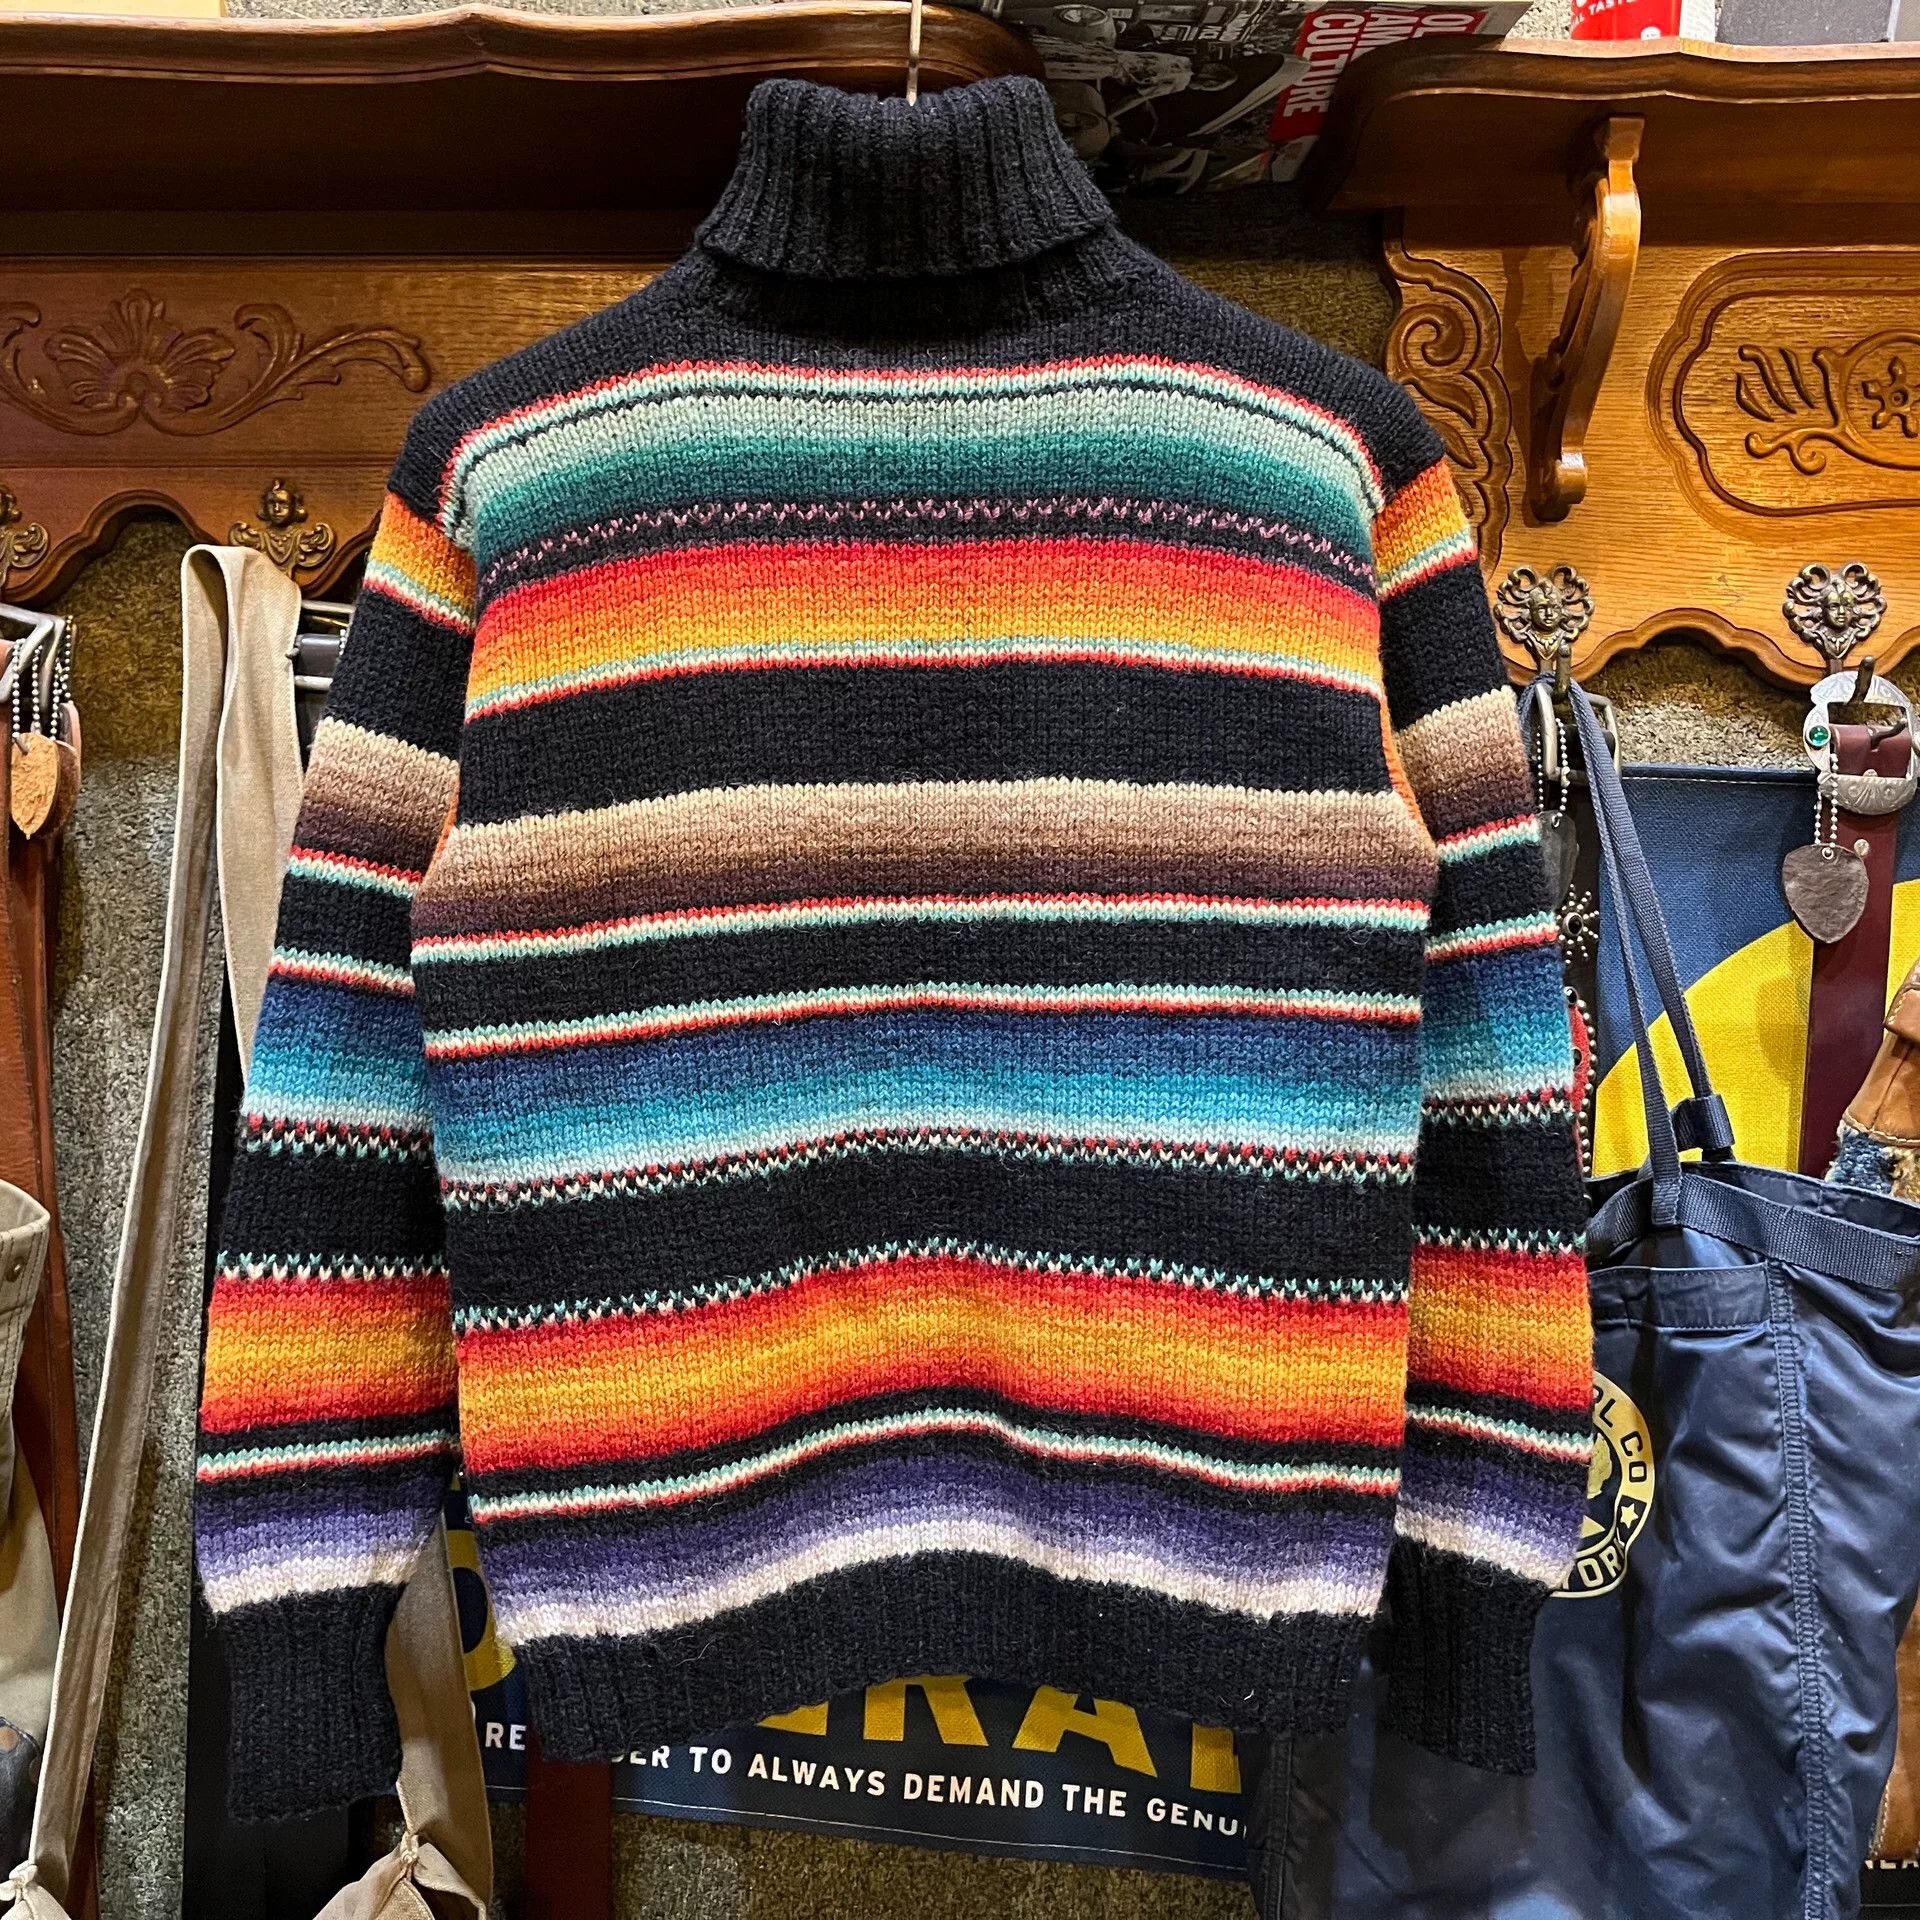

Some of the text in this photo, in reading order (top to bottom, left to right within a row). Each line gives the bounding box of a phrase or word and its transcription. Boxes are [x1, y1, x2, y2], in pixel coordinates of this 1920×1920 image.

[1283, 13, 1365, 118] CULTURE
[1620, 1431, 1648, 1483] CO
[689, 1746, 733, 1775] TO
[747, 1753, 886, 1797] ALWAYS
[903, 1773, 1045, 1809] DEMAND
[1062, 1783, 1128, 1818] THE
[1146, 1797, 1248, 1840] GENU
